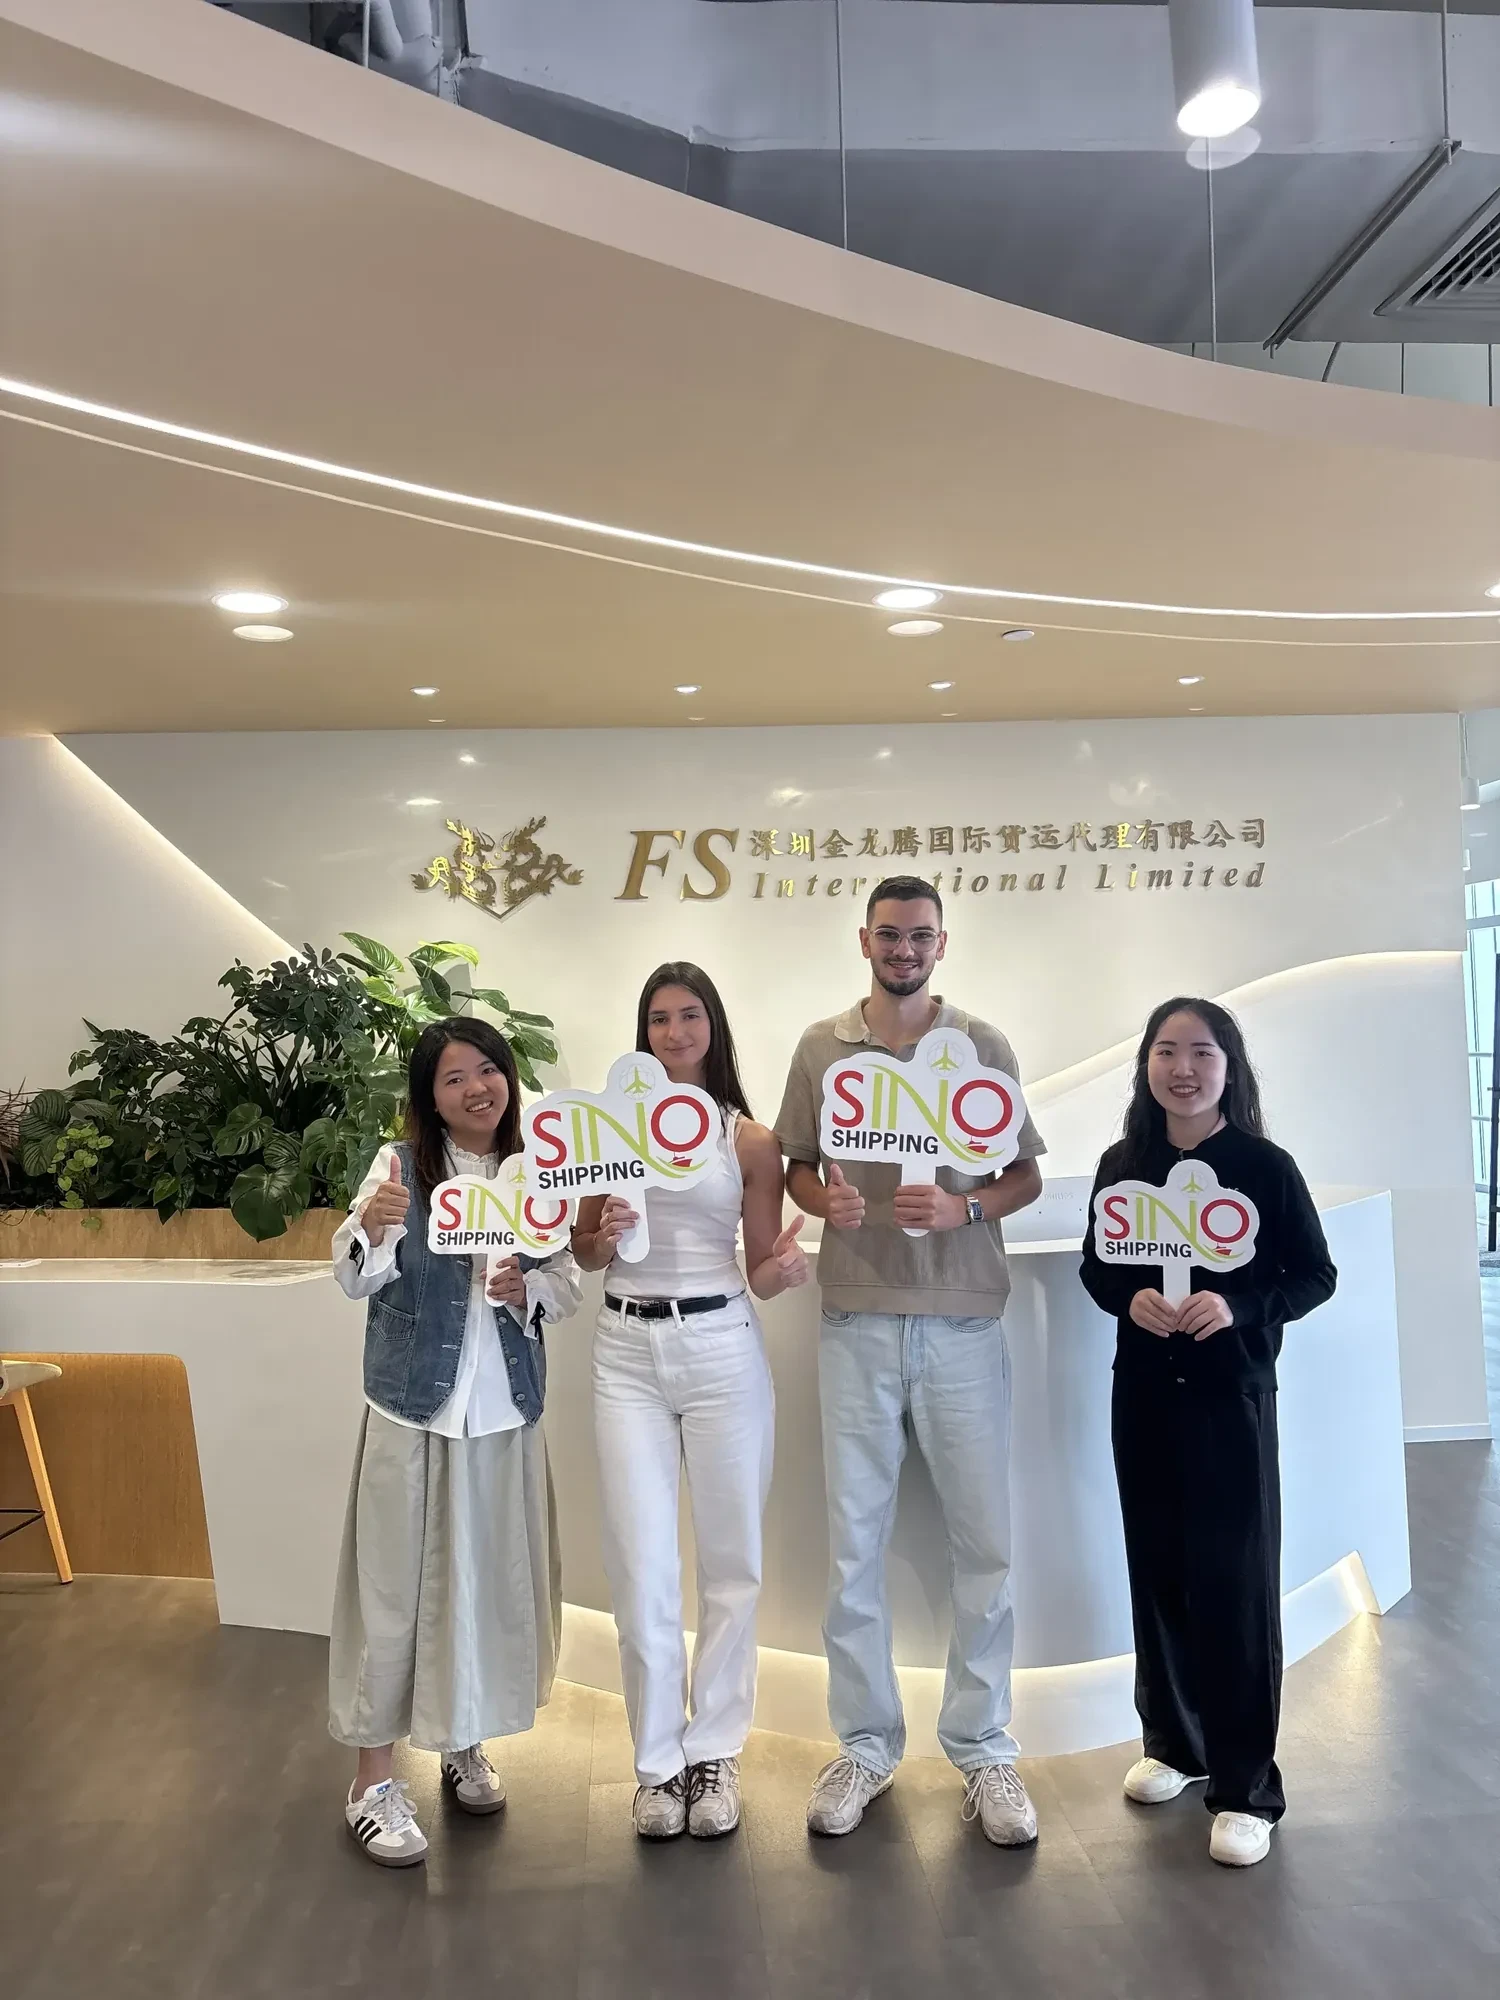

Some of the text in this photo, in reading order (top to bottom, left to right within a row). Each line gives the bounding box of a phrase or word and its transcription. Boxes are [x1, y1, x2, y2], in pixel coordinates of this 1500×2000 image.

[613, 827, 740, 901] FS
[753, 861, 1265, 899] Intertional Limited
[832, 1065, 1013, 1139] SINO
[532, 1094, 710, 1174] SINO
[831, 1129, 939, 1155] SHIPPING
[538, 1159, 645, 1190] SHIPPING
[437, 1184, 568, 1236] SINO
[1104, 1192, 1250, 1244] SINO
[436, 1231, 515, 1246] SHIPPING
[1105, 1241, 1192, 1258] SHIPPING
